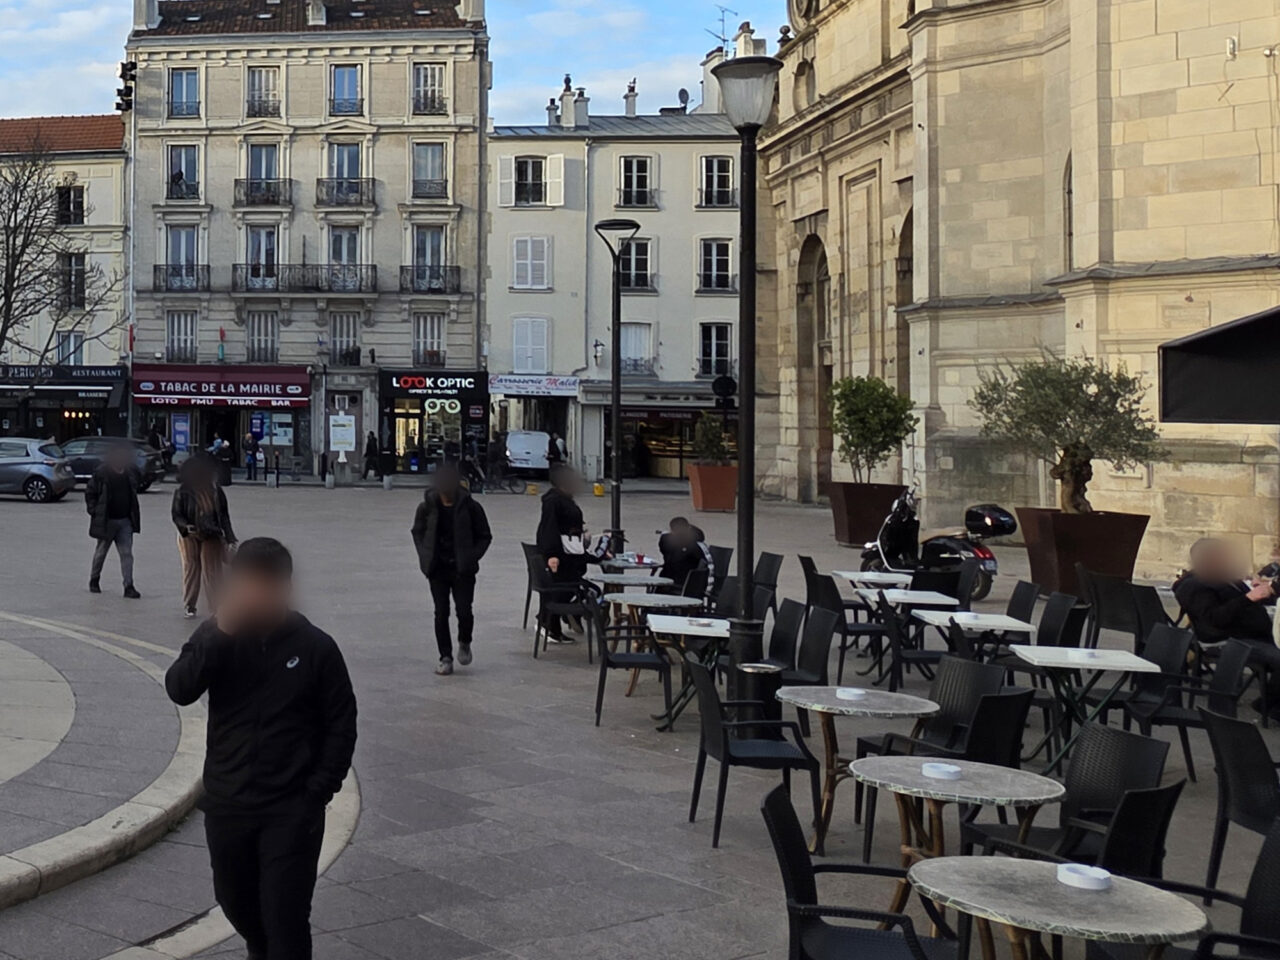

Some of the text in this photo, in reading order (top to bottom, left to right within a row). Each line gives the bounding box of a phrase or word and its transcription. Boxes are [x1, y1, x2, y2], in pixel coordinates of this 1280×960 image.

[72, 369, 121, 377] RESTAURANT
[392, 376, 475, 388] LOOK OPTIC
[159, 382, 198, 392] TABAC
[201, 383, 216, 393] DE
[220, 383, 235, 393] LA
[239, 383, 282, 394] MAIRIE
[150, 397, 178, 405] LOTO
[190, 397, 214, 405] PMU
[226, 399, 259, 407] TABAC
